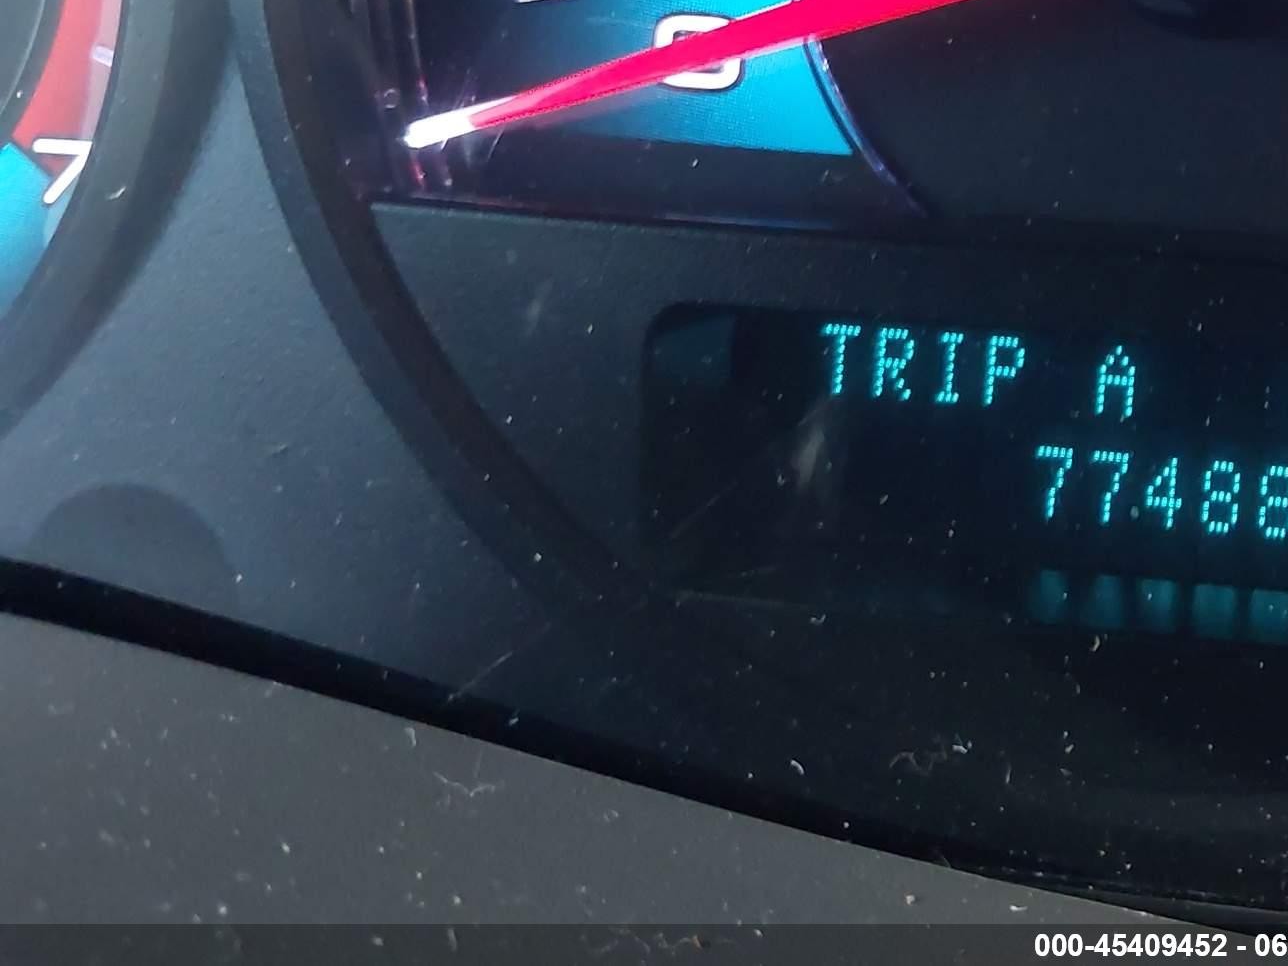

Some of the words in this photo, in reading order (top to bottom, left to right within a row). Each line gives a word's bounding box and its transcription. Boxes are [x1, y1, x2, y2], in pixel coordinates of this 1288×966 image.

[33, 138, 92, 204] 7
[821, 323, 1026, 405] TRIP
[1096, 345, 1136, 420] A
